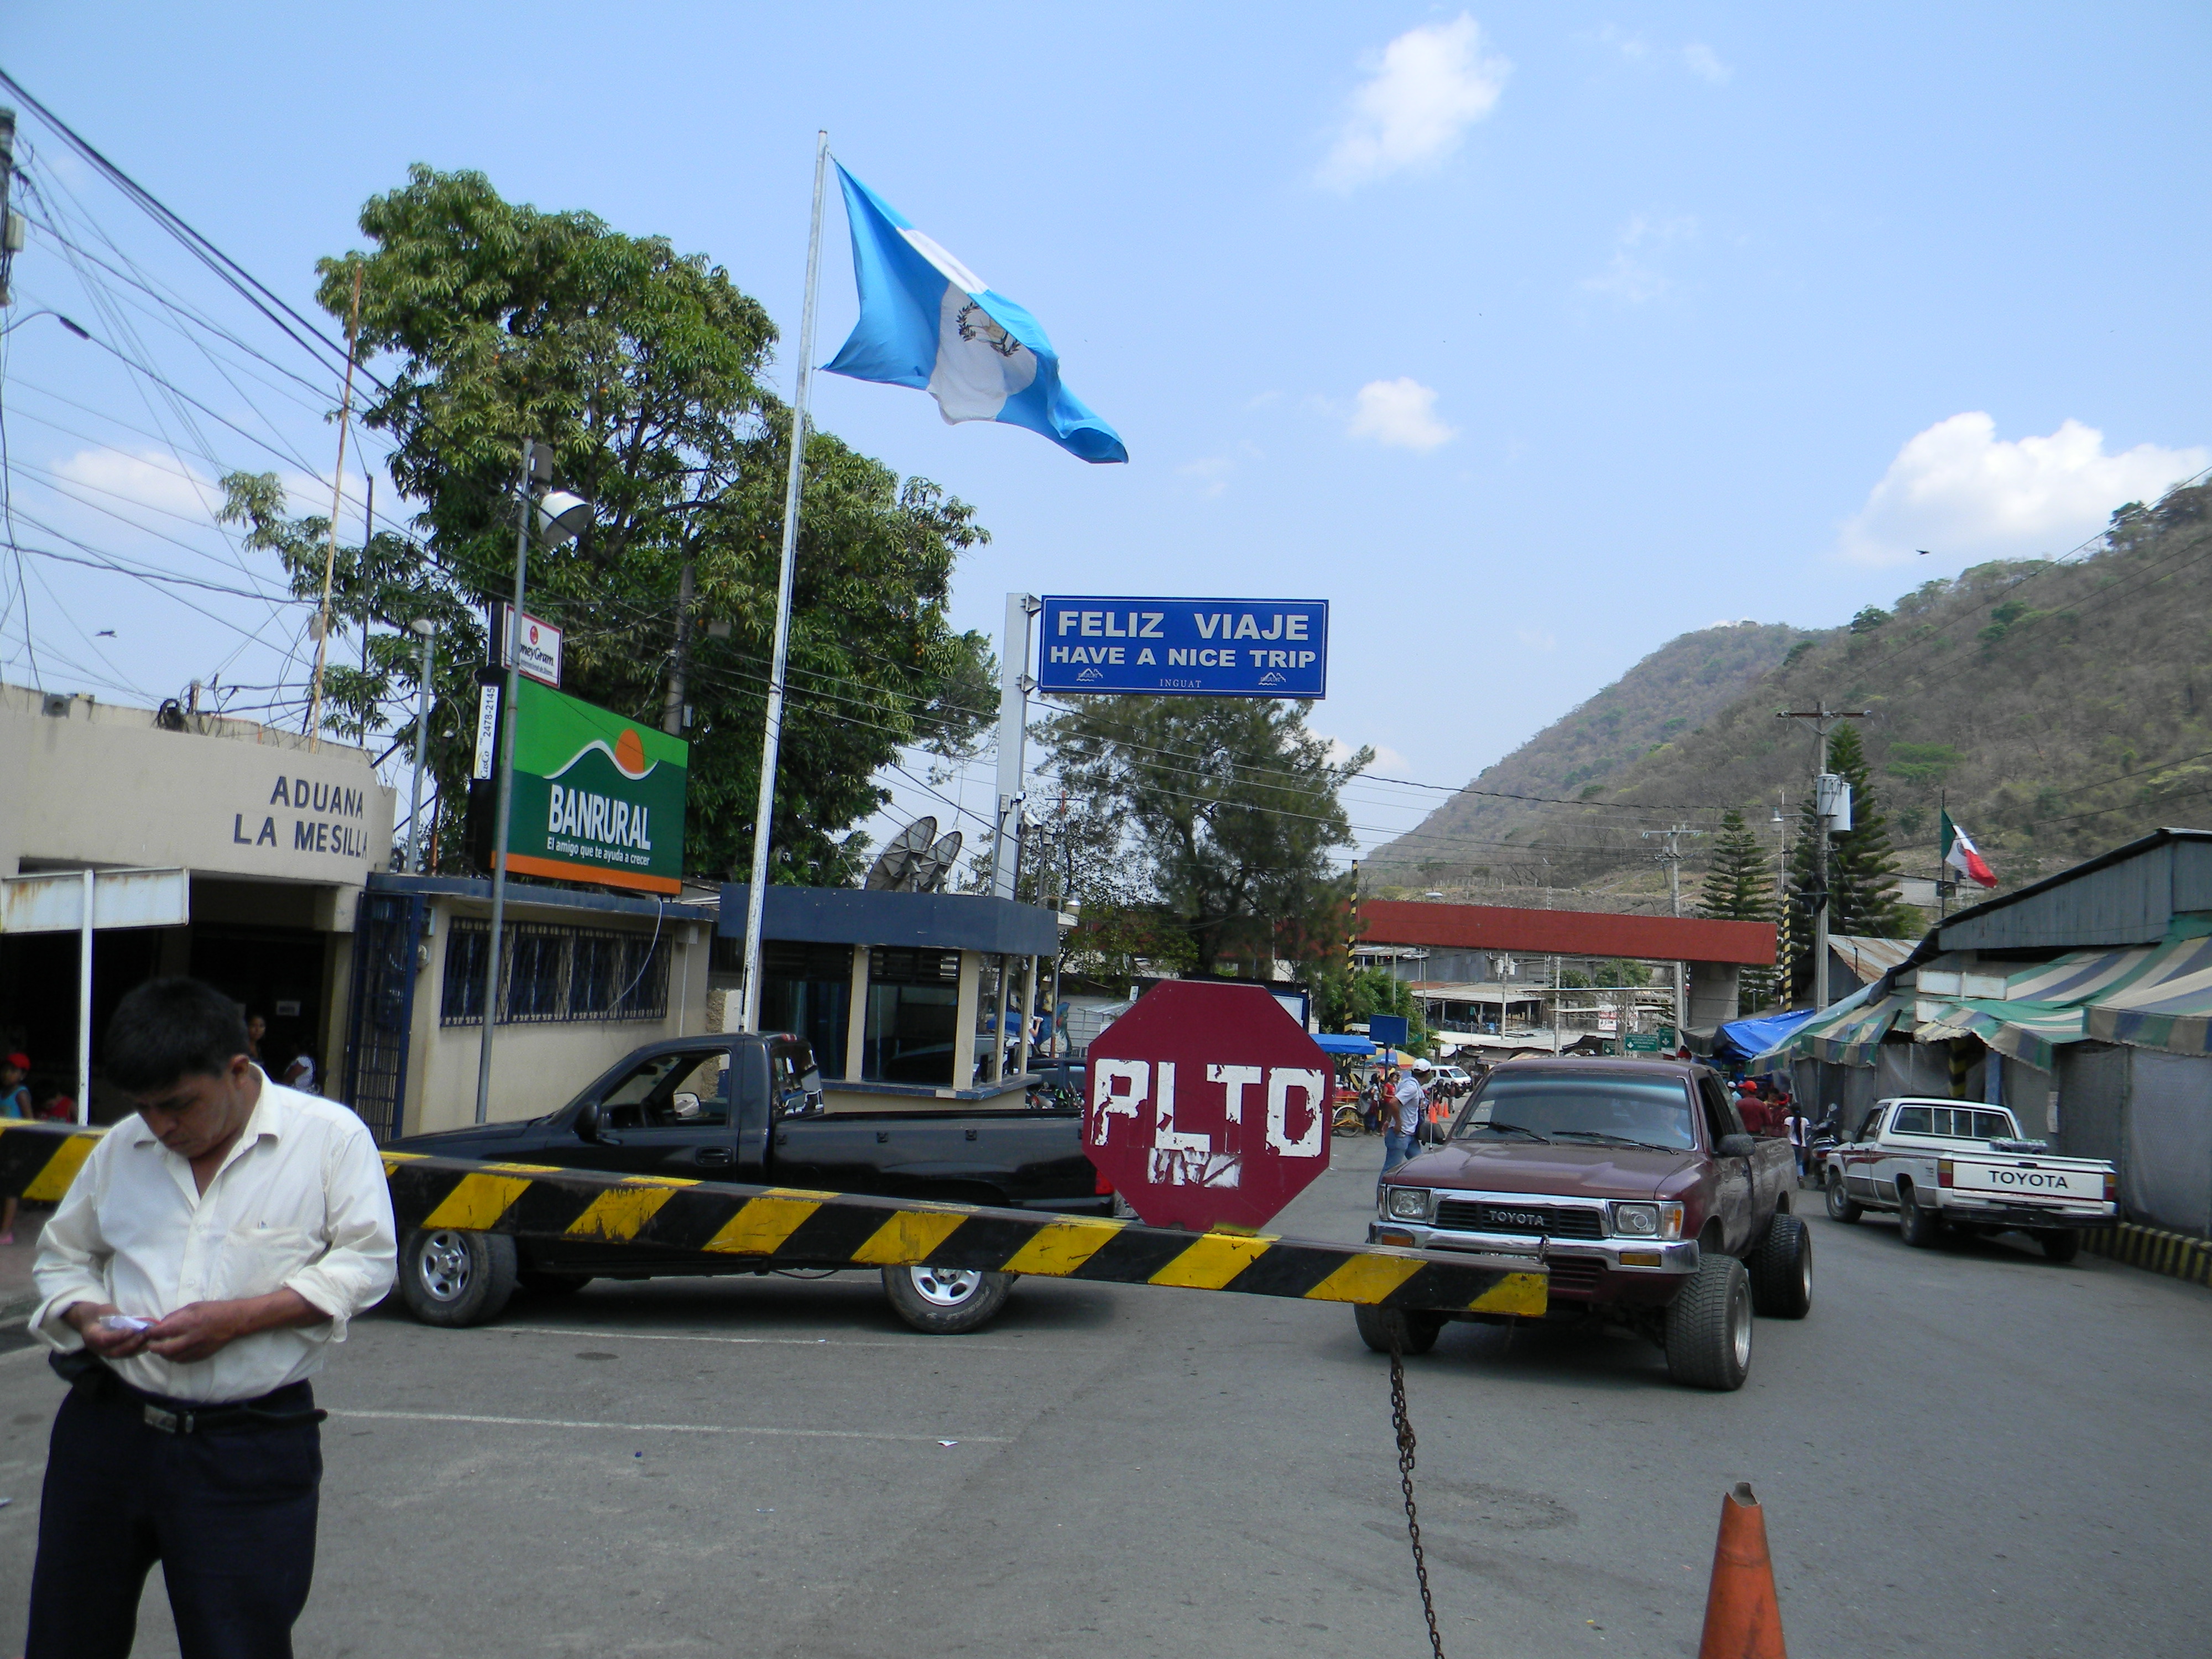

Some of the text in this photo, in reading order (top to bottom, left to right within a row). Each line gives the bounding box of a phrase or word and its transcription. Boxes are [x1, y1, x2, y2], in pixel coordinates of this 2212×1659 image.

[1058, 611, 1309, 640] FELIZ VIAJE
[1050, 646, 1316, 668] HAVE A NICE TRIP
[1160, 679, 1202, 688] INGUAT
[483, 687, 495, 738] 2478-2145
[481, 751, 490, 779] CasCo
[269, 776, 363, 820] ADUANA
[548, 784, 651, 851] BANRURAL
[233, 813, 368, 859] LA MESILLA
[547, 837, 651, 866] El amigo que te ayuda a crecer
[1988, 1170, 2069, 1190] TOYOTA
[1489, 1210, 1545, 1227] TOYOTA
